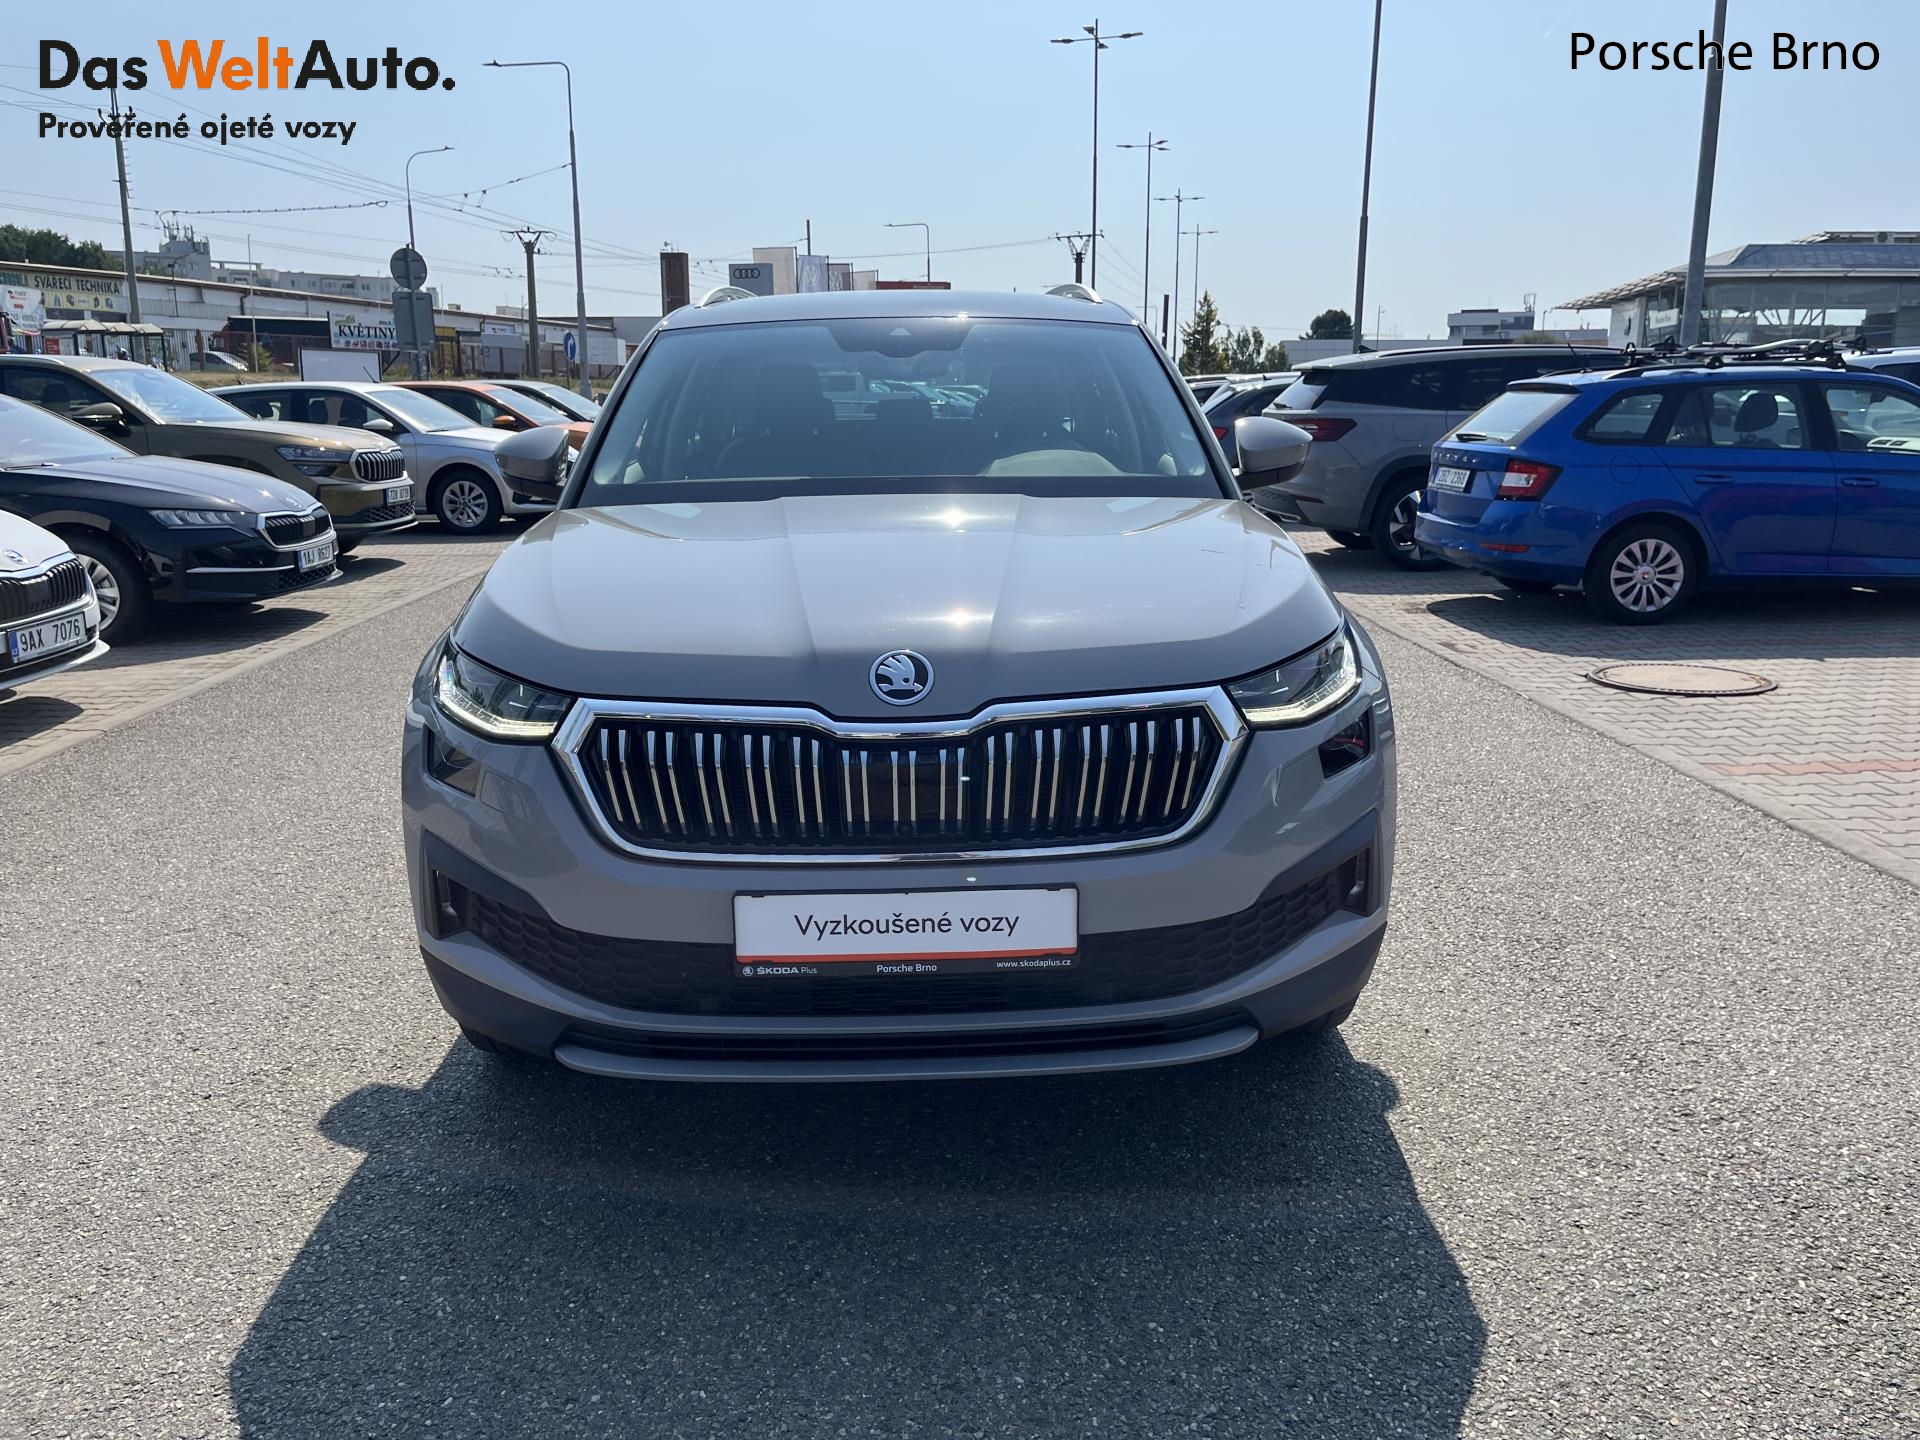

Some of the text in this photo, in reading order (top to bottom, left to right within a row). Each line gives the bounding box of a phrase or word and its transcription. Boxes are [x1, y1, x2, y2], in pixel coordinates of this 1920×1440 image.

[75, 279, 120, 295] TECHNIKA
[338, 323, 396, 339] KVĚTINY
[20, 629, 44, 652] 9AX
[52, 619, 80, 642] 7076
[794, 913, 1020, 941] Vyzkoušené vozy
[756, 966, 818, 976] ŠKODA Plus
[876, 963, 937, 974] Porsche Brno
[996, 958, 1071, 969] www.skodaplus.cz
